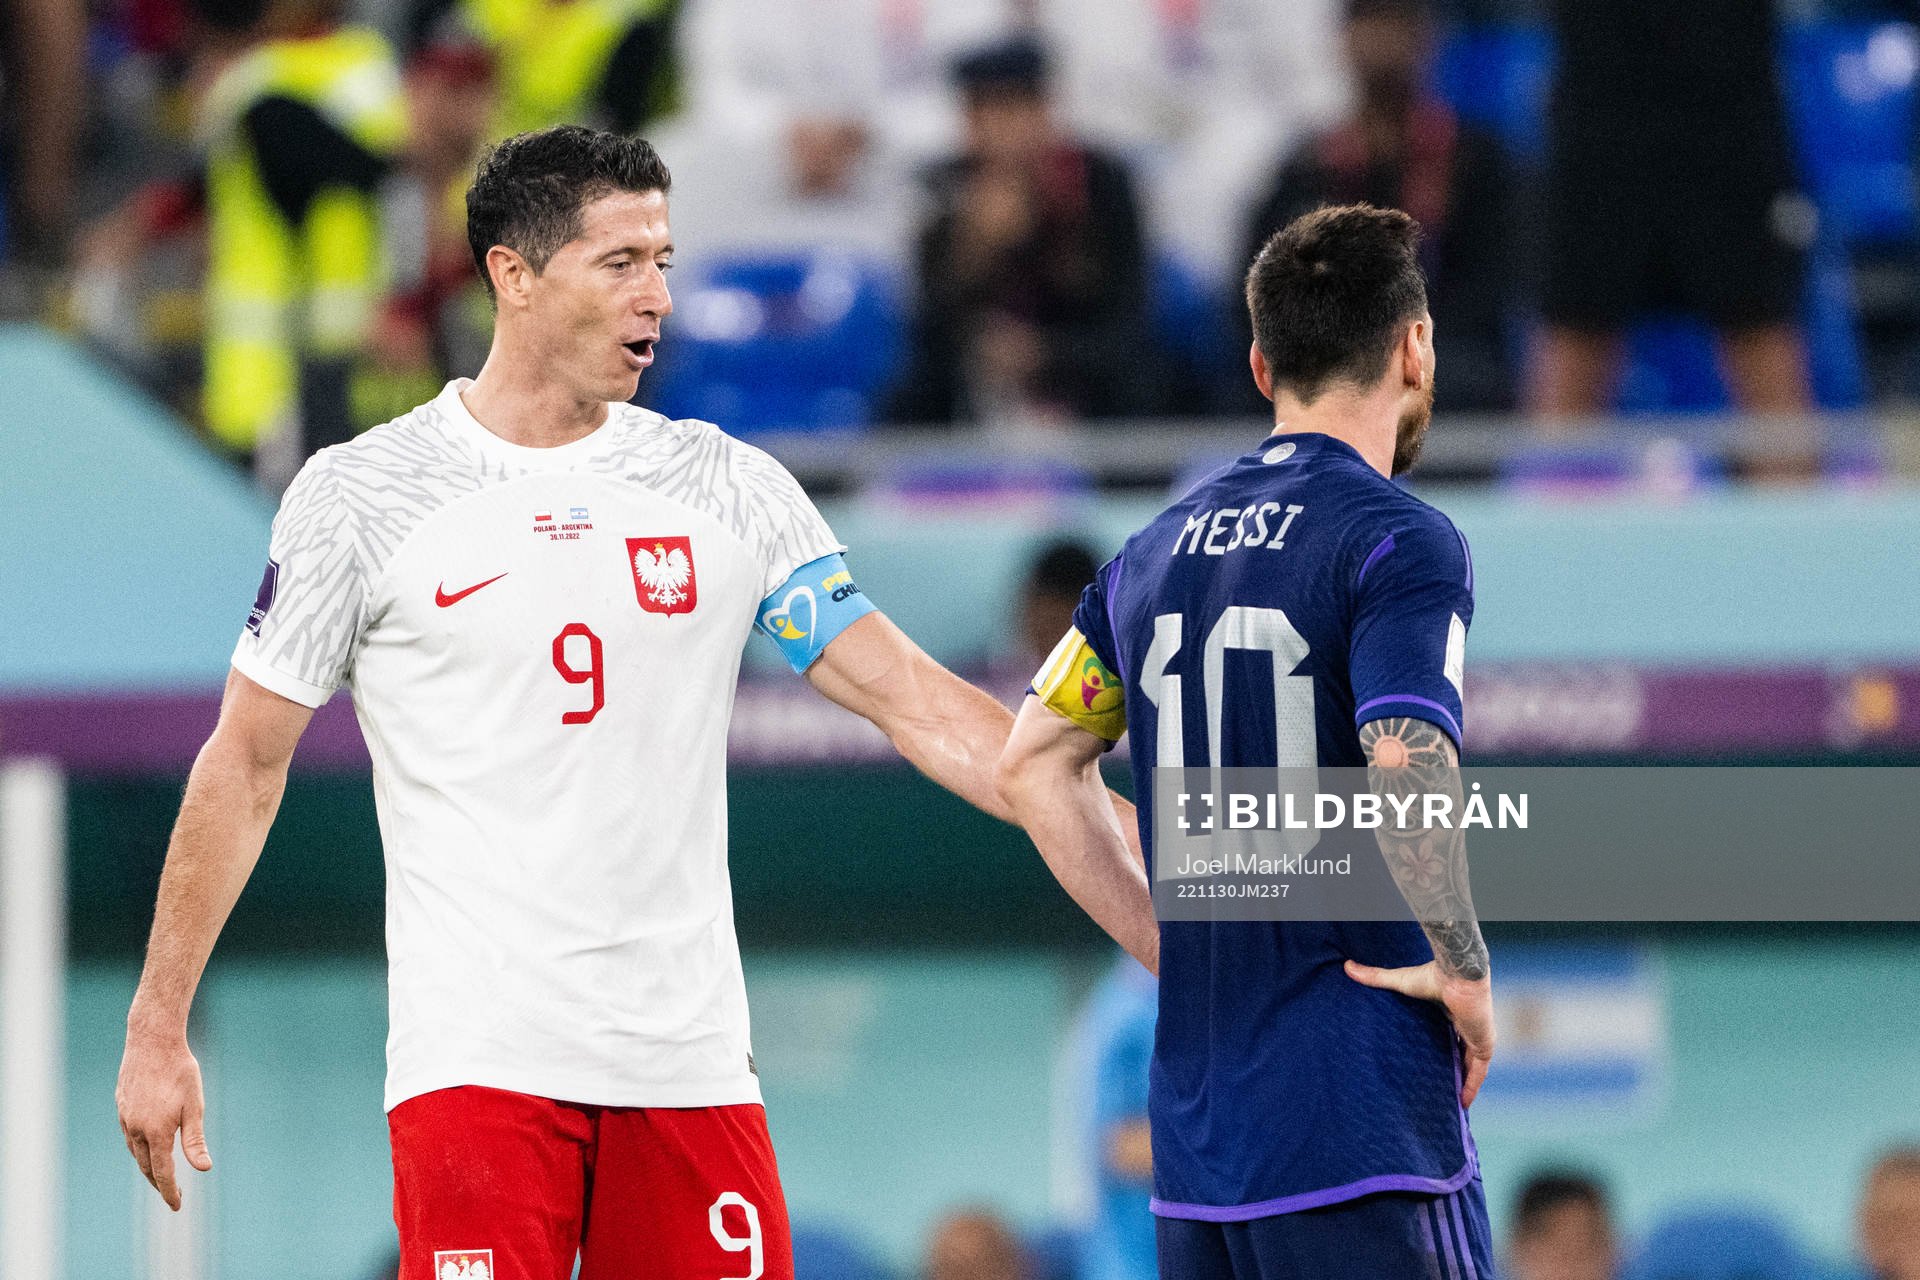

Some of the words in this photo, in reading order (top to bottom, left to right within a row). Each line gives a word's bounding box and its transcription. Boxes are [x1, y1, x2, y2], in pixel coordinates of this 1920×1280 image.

[533, 525, 557, 533] POLAND
[561, 523, 594, 531] ARGENTINA
[549, 533, 580, 541] 30.11.2022
[1172, 502, 1305, 555] MESSI
[552, 623, 604, 724] 9
[1139, 605, 1321, 882] 10
[708, 1191, 764, 1280] 9
